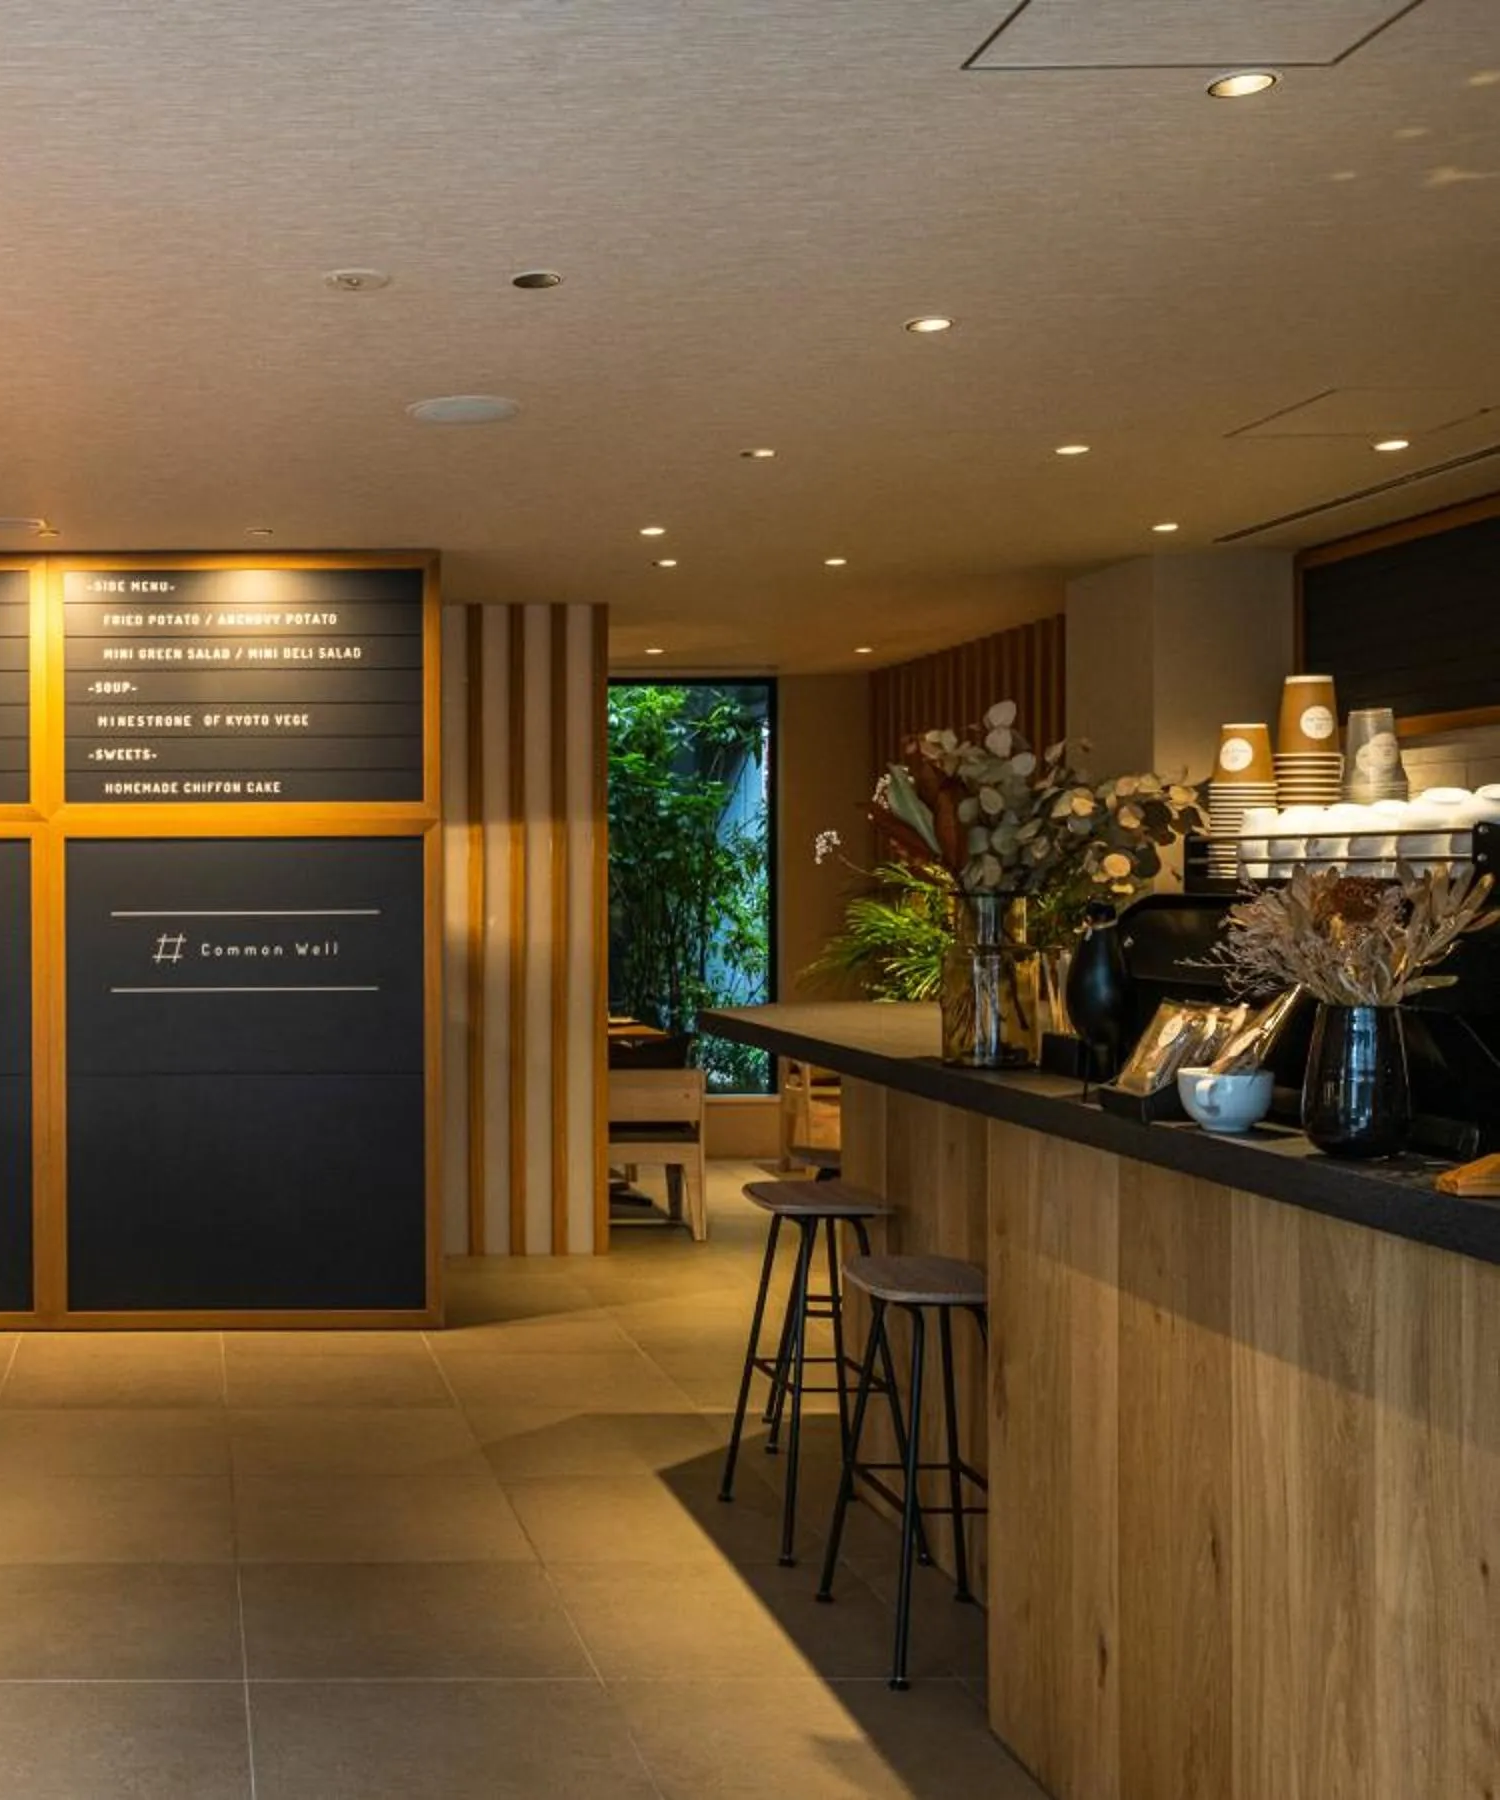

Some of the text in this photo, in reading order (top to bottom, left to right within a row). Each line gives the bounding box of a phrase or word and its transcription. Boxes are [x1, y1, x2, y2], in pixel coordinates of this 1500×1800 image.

[130, 580, 176, 593] MENU-
[103, 614, 143, 626] FRIED
[147, 613, 201, 626] POTATO
[286, 612, 338, 625] POTATO
[103, 647, 133, 660] MINI
[138, 647, 183, 660] GREEN
[187, 647, 231, 660] SALAD
[248, 647, 278, 659] MINI
[318, 646, 362, 659] SALAD
[87, 681, 138, 694] -SOUP-
[97, 714, 309, 728] MINESTRONE OF KYOTO VEGE
[88, 748, 158, 761] -SWEETS-
[104, 781, 282, 795] HOMEMADE CHIFFON CAKE
[200, 942, 284, 957] Common
[295, 941, 339, 956] Well
